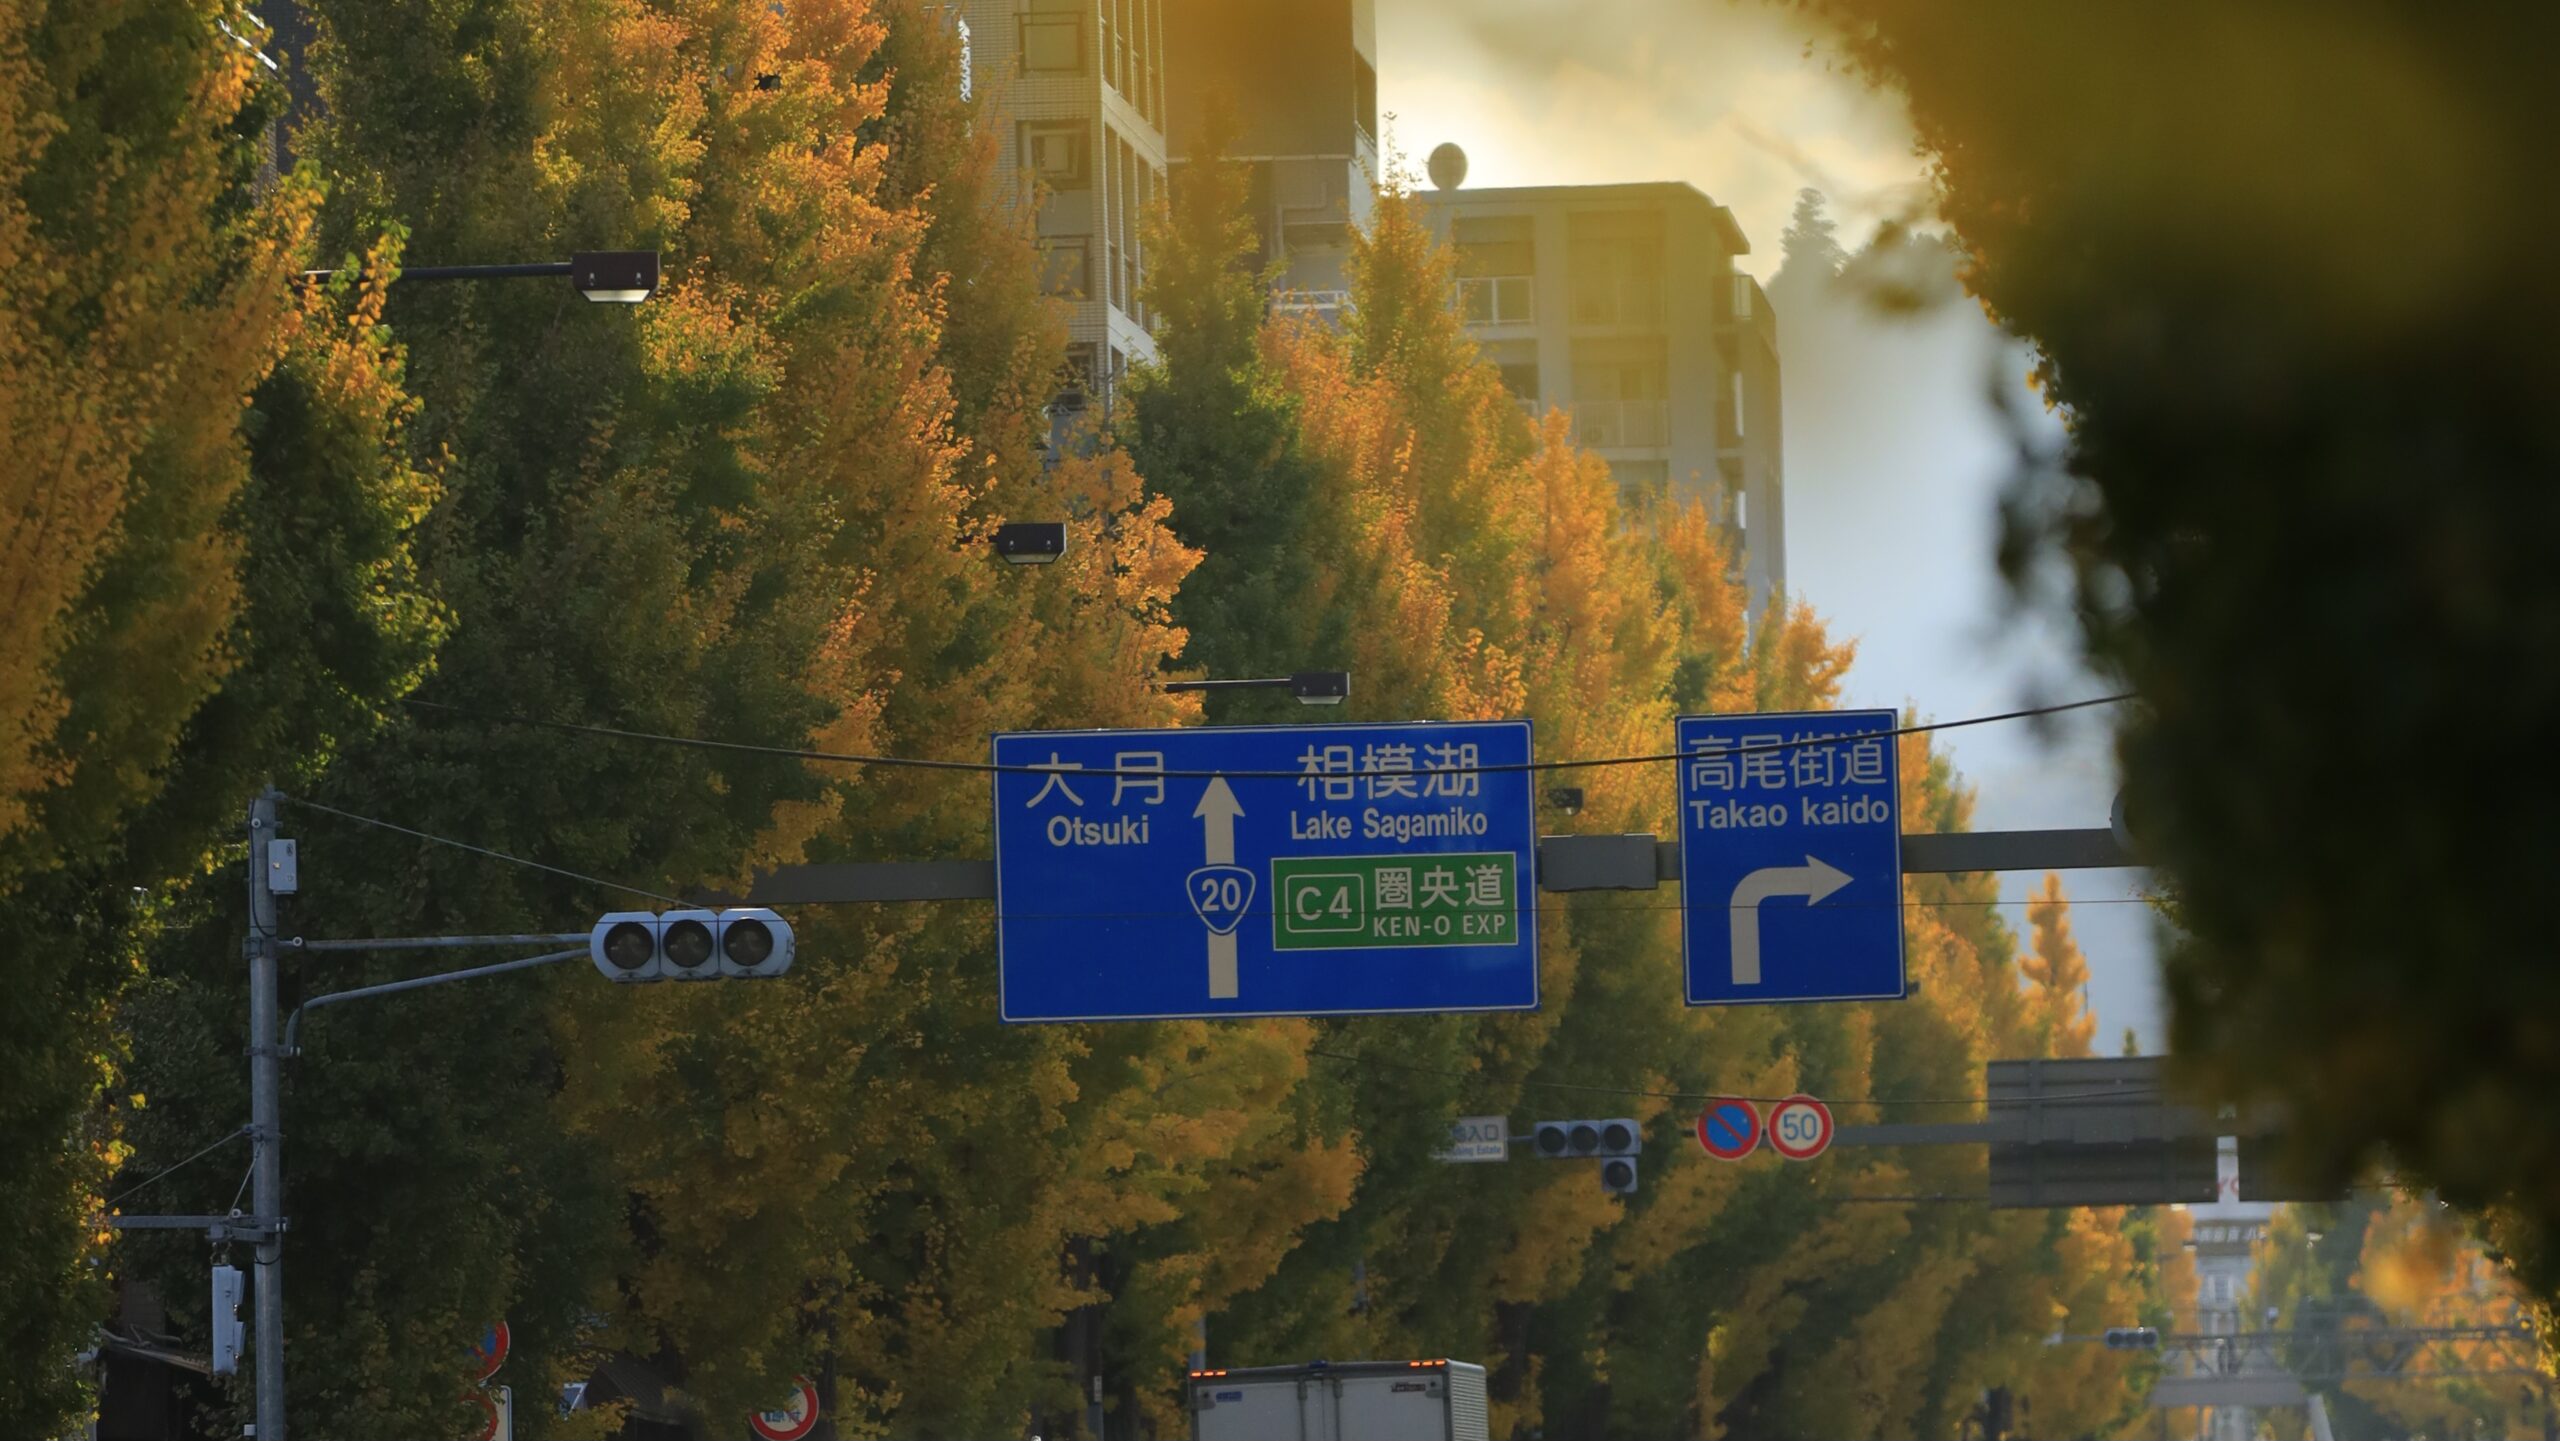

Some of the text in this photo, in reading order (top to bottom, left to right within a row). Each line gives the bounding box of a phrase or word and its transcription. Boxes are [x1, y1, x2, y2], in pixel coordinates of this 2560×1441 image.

[1297, 742, 1479, 801] 相模湖
[1689, 729, 1887, 792] 高尾街道
[1026, 752, 1165, 808] 大月
[1291, 807, 1488, 843] Lake Sagamiko
[1689, 795, 1889, 829] Takao kaido
[1047, 814, 1149, 847] Otsuki
[1202, 878, 1241, 911] 20
[1296, 886, 1352, 921] C4
[1374, 864, 1505, 910] 圏央道
[1373, 914, 1506, 937] KEN-O EXP
[1783, 1112, 1818, 1140] 50
